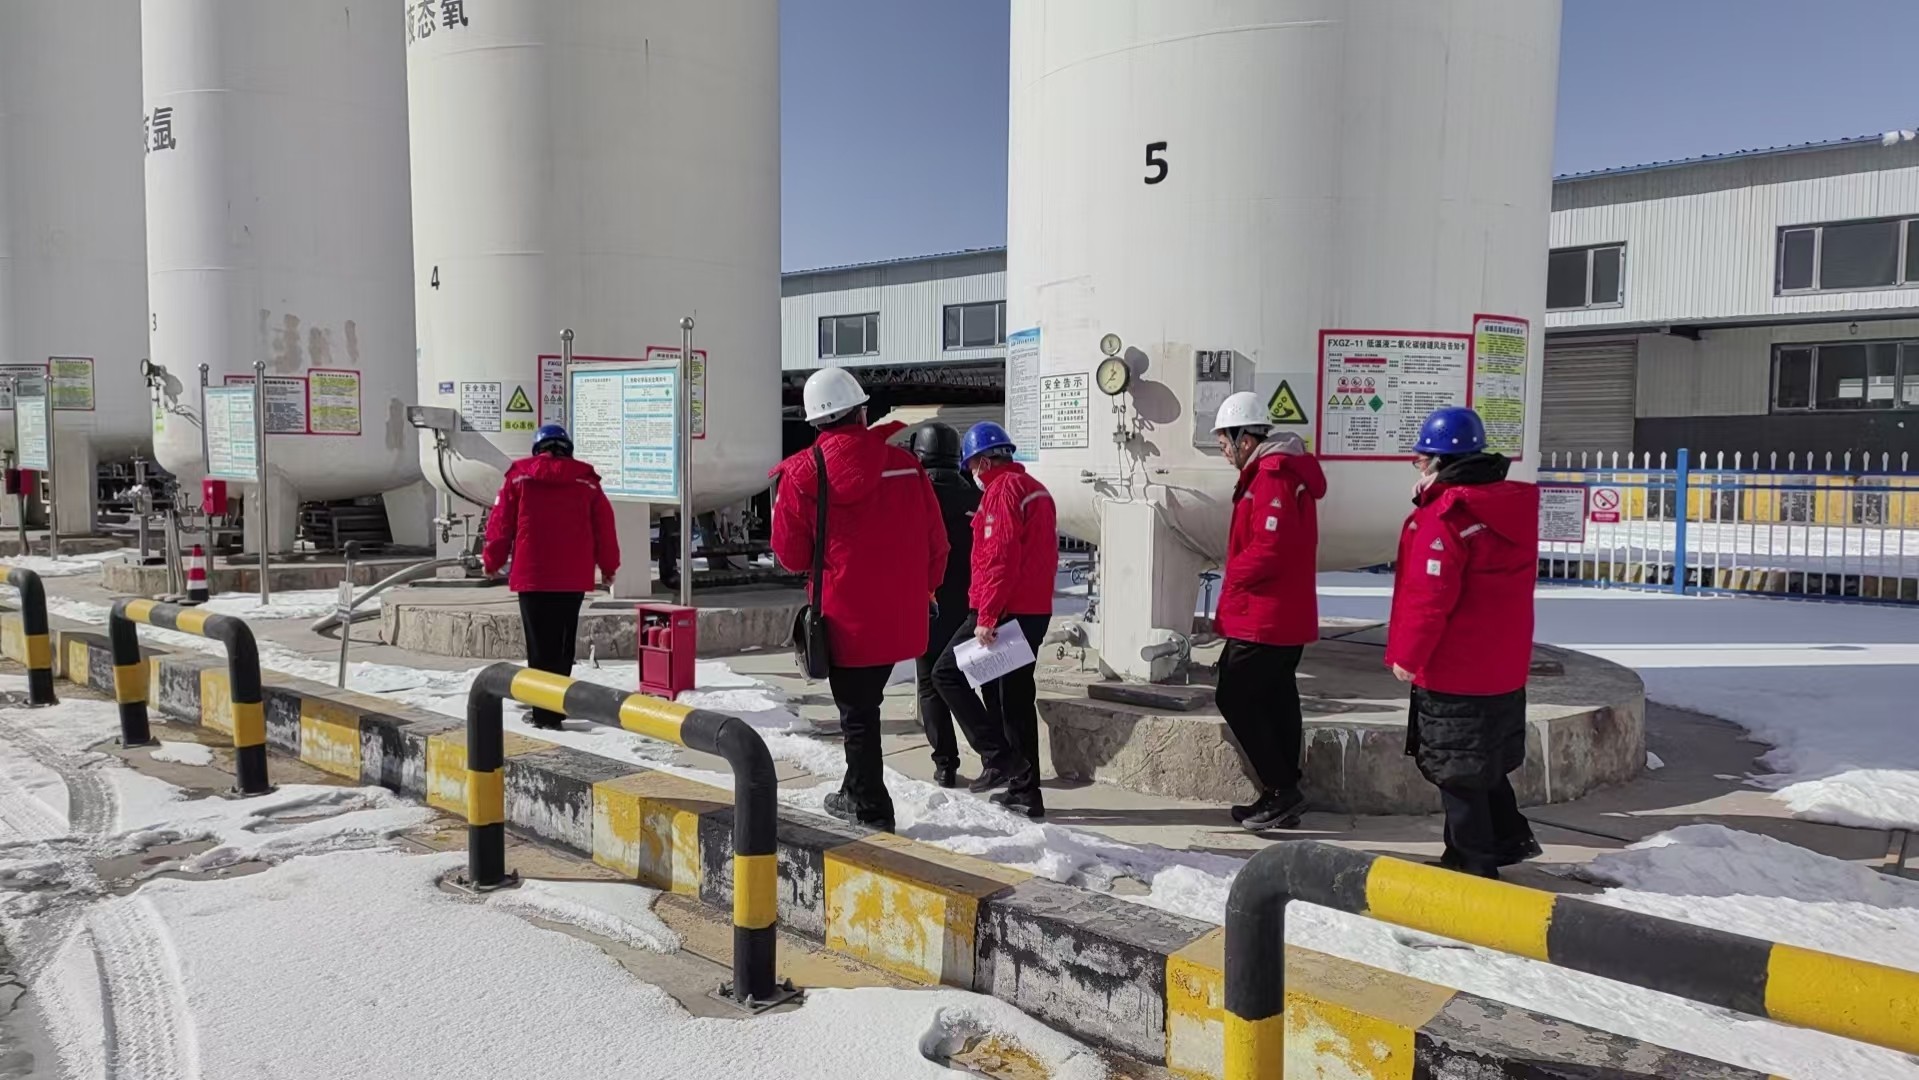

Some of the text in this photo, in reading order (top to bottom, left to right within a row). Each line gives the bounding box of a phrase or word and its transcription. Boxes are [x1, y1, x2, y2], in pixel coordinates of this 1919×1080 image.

[1144, 141, 1168, 184] 5
[431, 266, 440, 290] 4
[152, 312, 157, 331] 3
[1328, 339, 1363, 348] FXGZ-11
[465, 383, 496, 392] 安全告示
[1045, 376, 1083, 390] 安全告示
[505, 421, 534, 430] 当心冻伤
